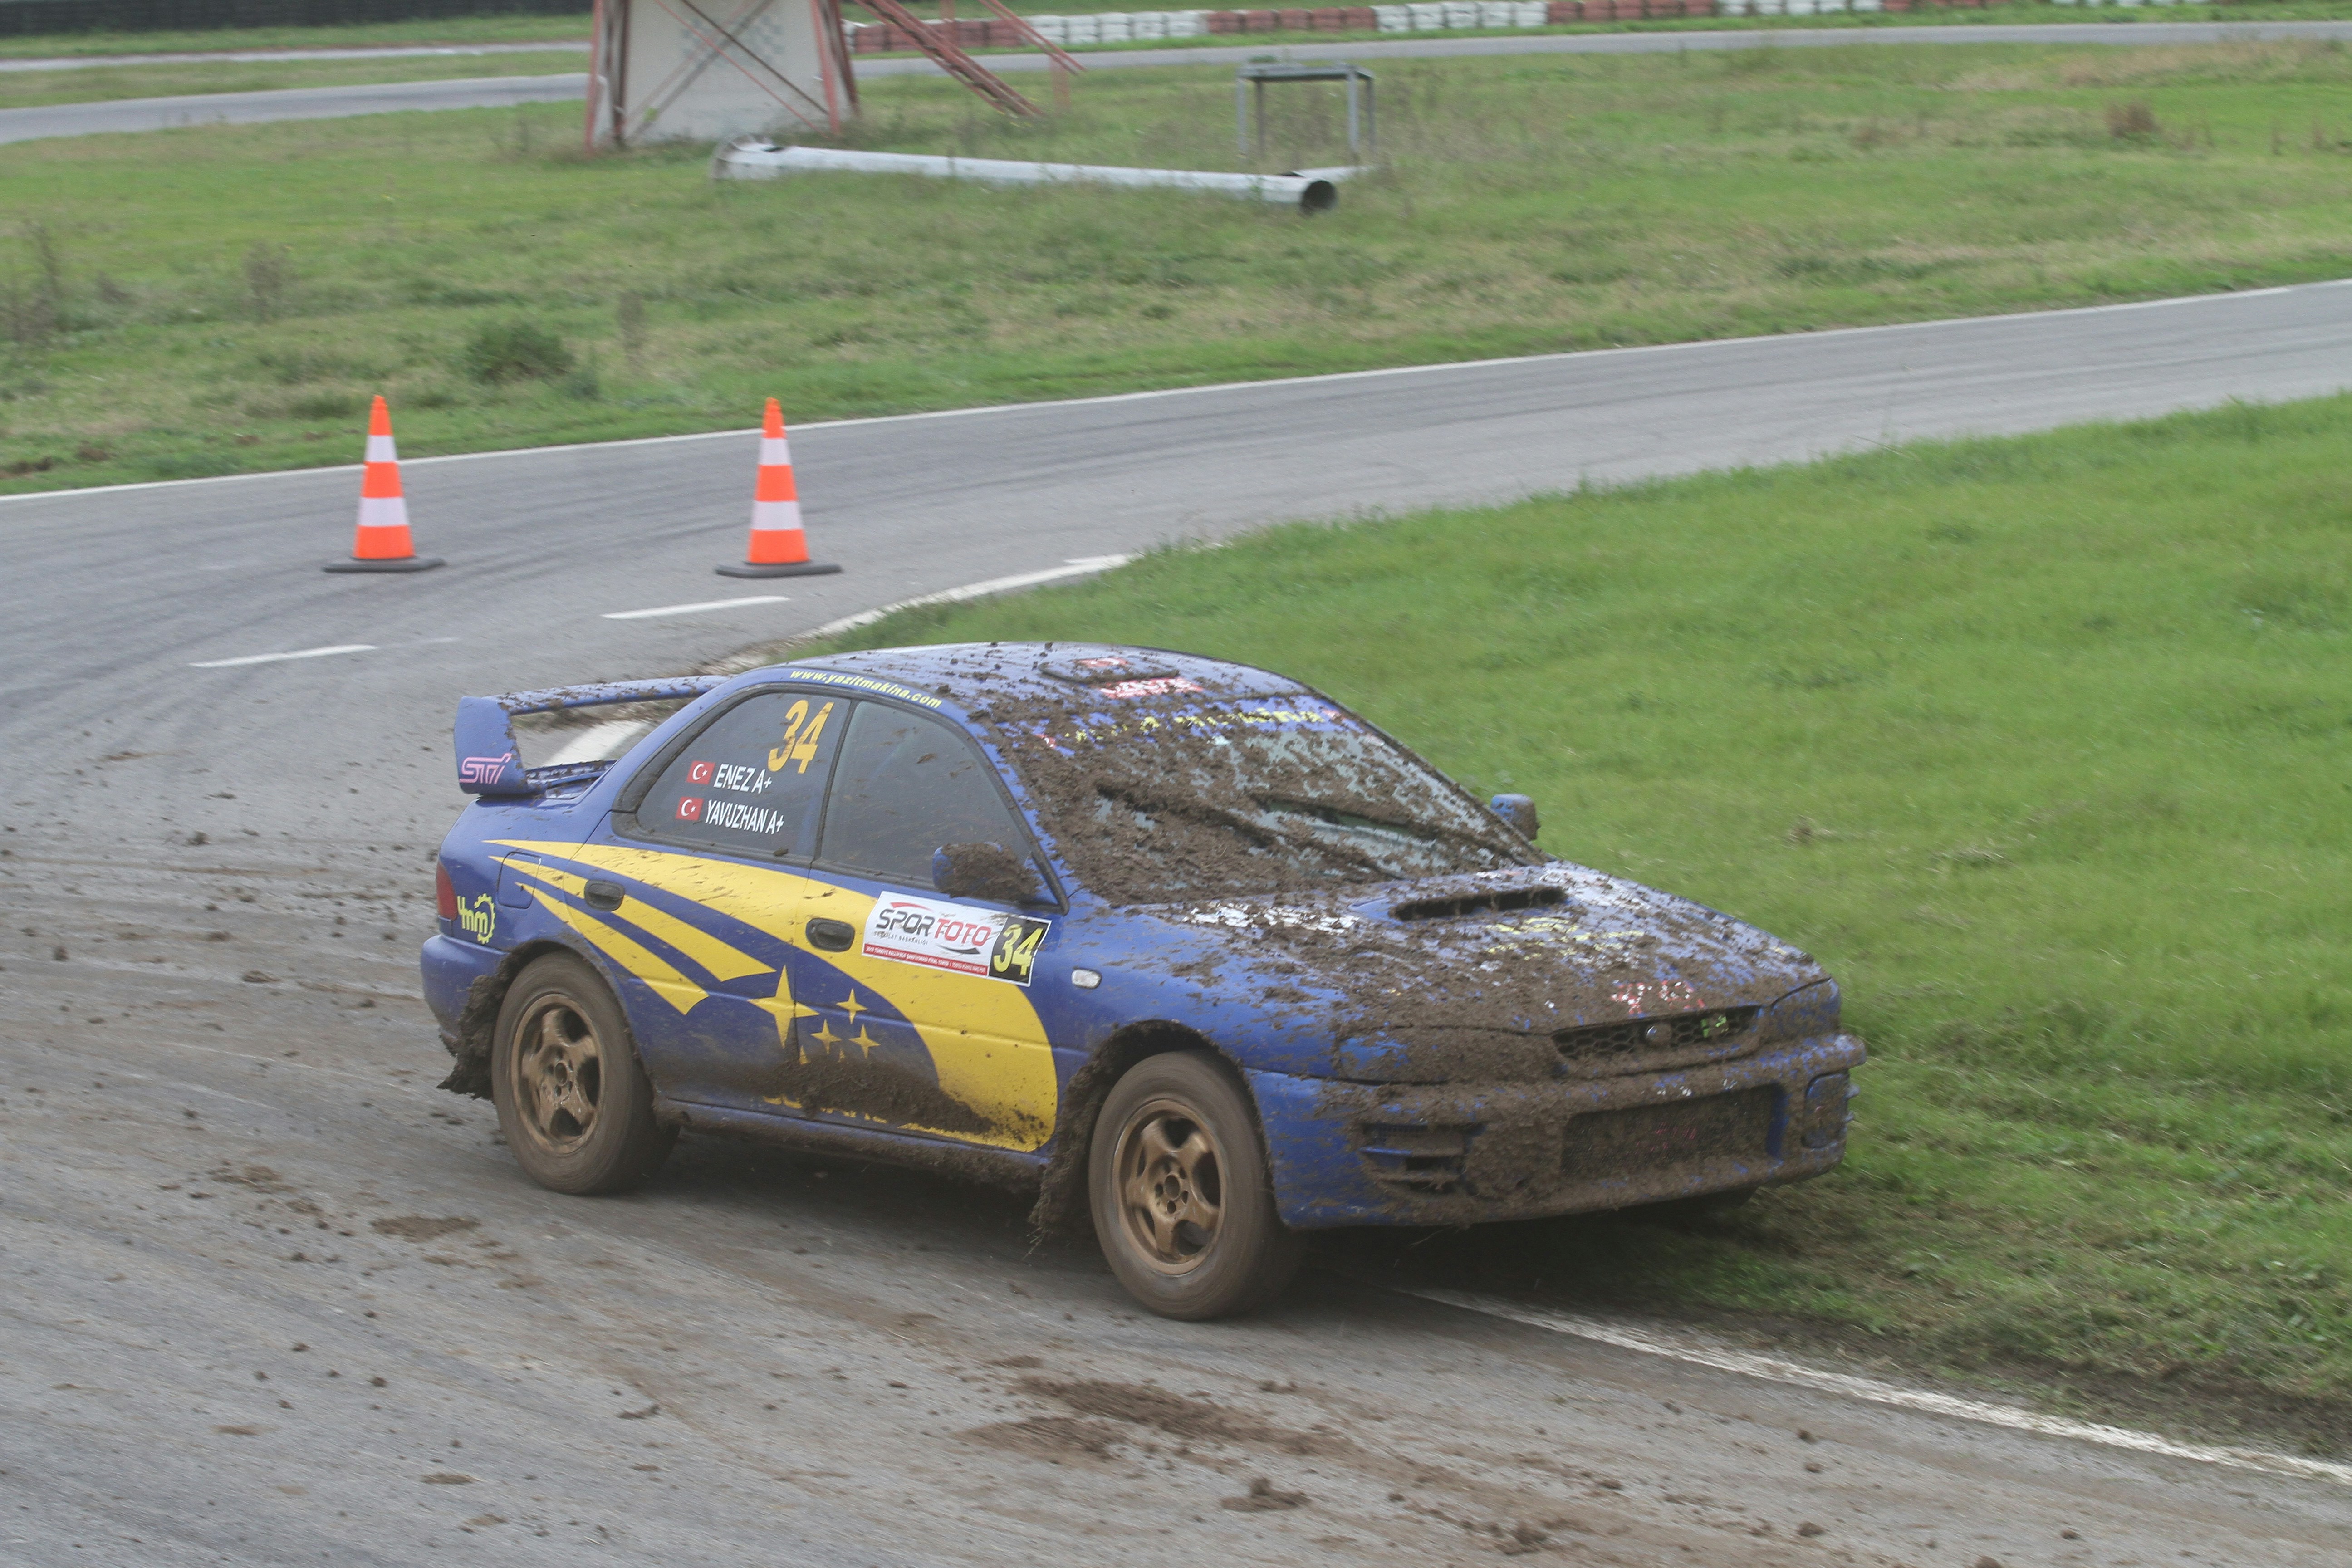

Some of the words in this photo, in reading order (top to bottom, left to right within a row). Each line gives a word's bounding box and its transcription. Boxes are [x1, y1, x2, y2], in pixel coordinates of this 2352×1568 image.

[767, 700, 834, 774] 34
[714, 764, 756, 792] ENEZ
[751, 769, 772, 794] A+
[705, 799, 769, 833] YAVUZHAN
[765, 810, 784, 835] A+
[993, 924, 1044, 975] 34
